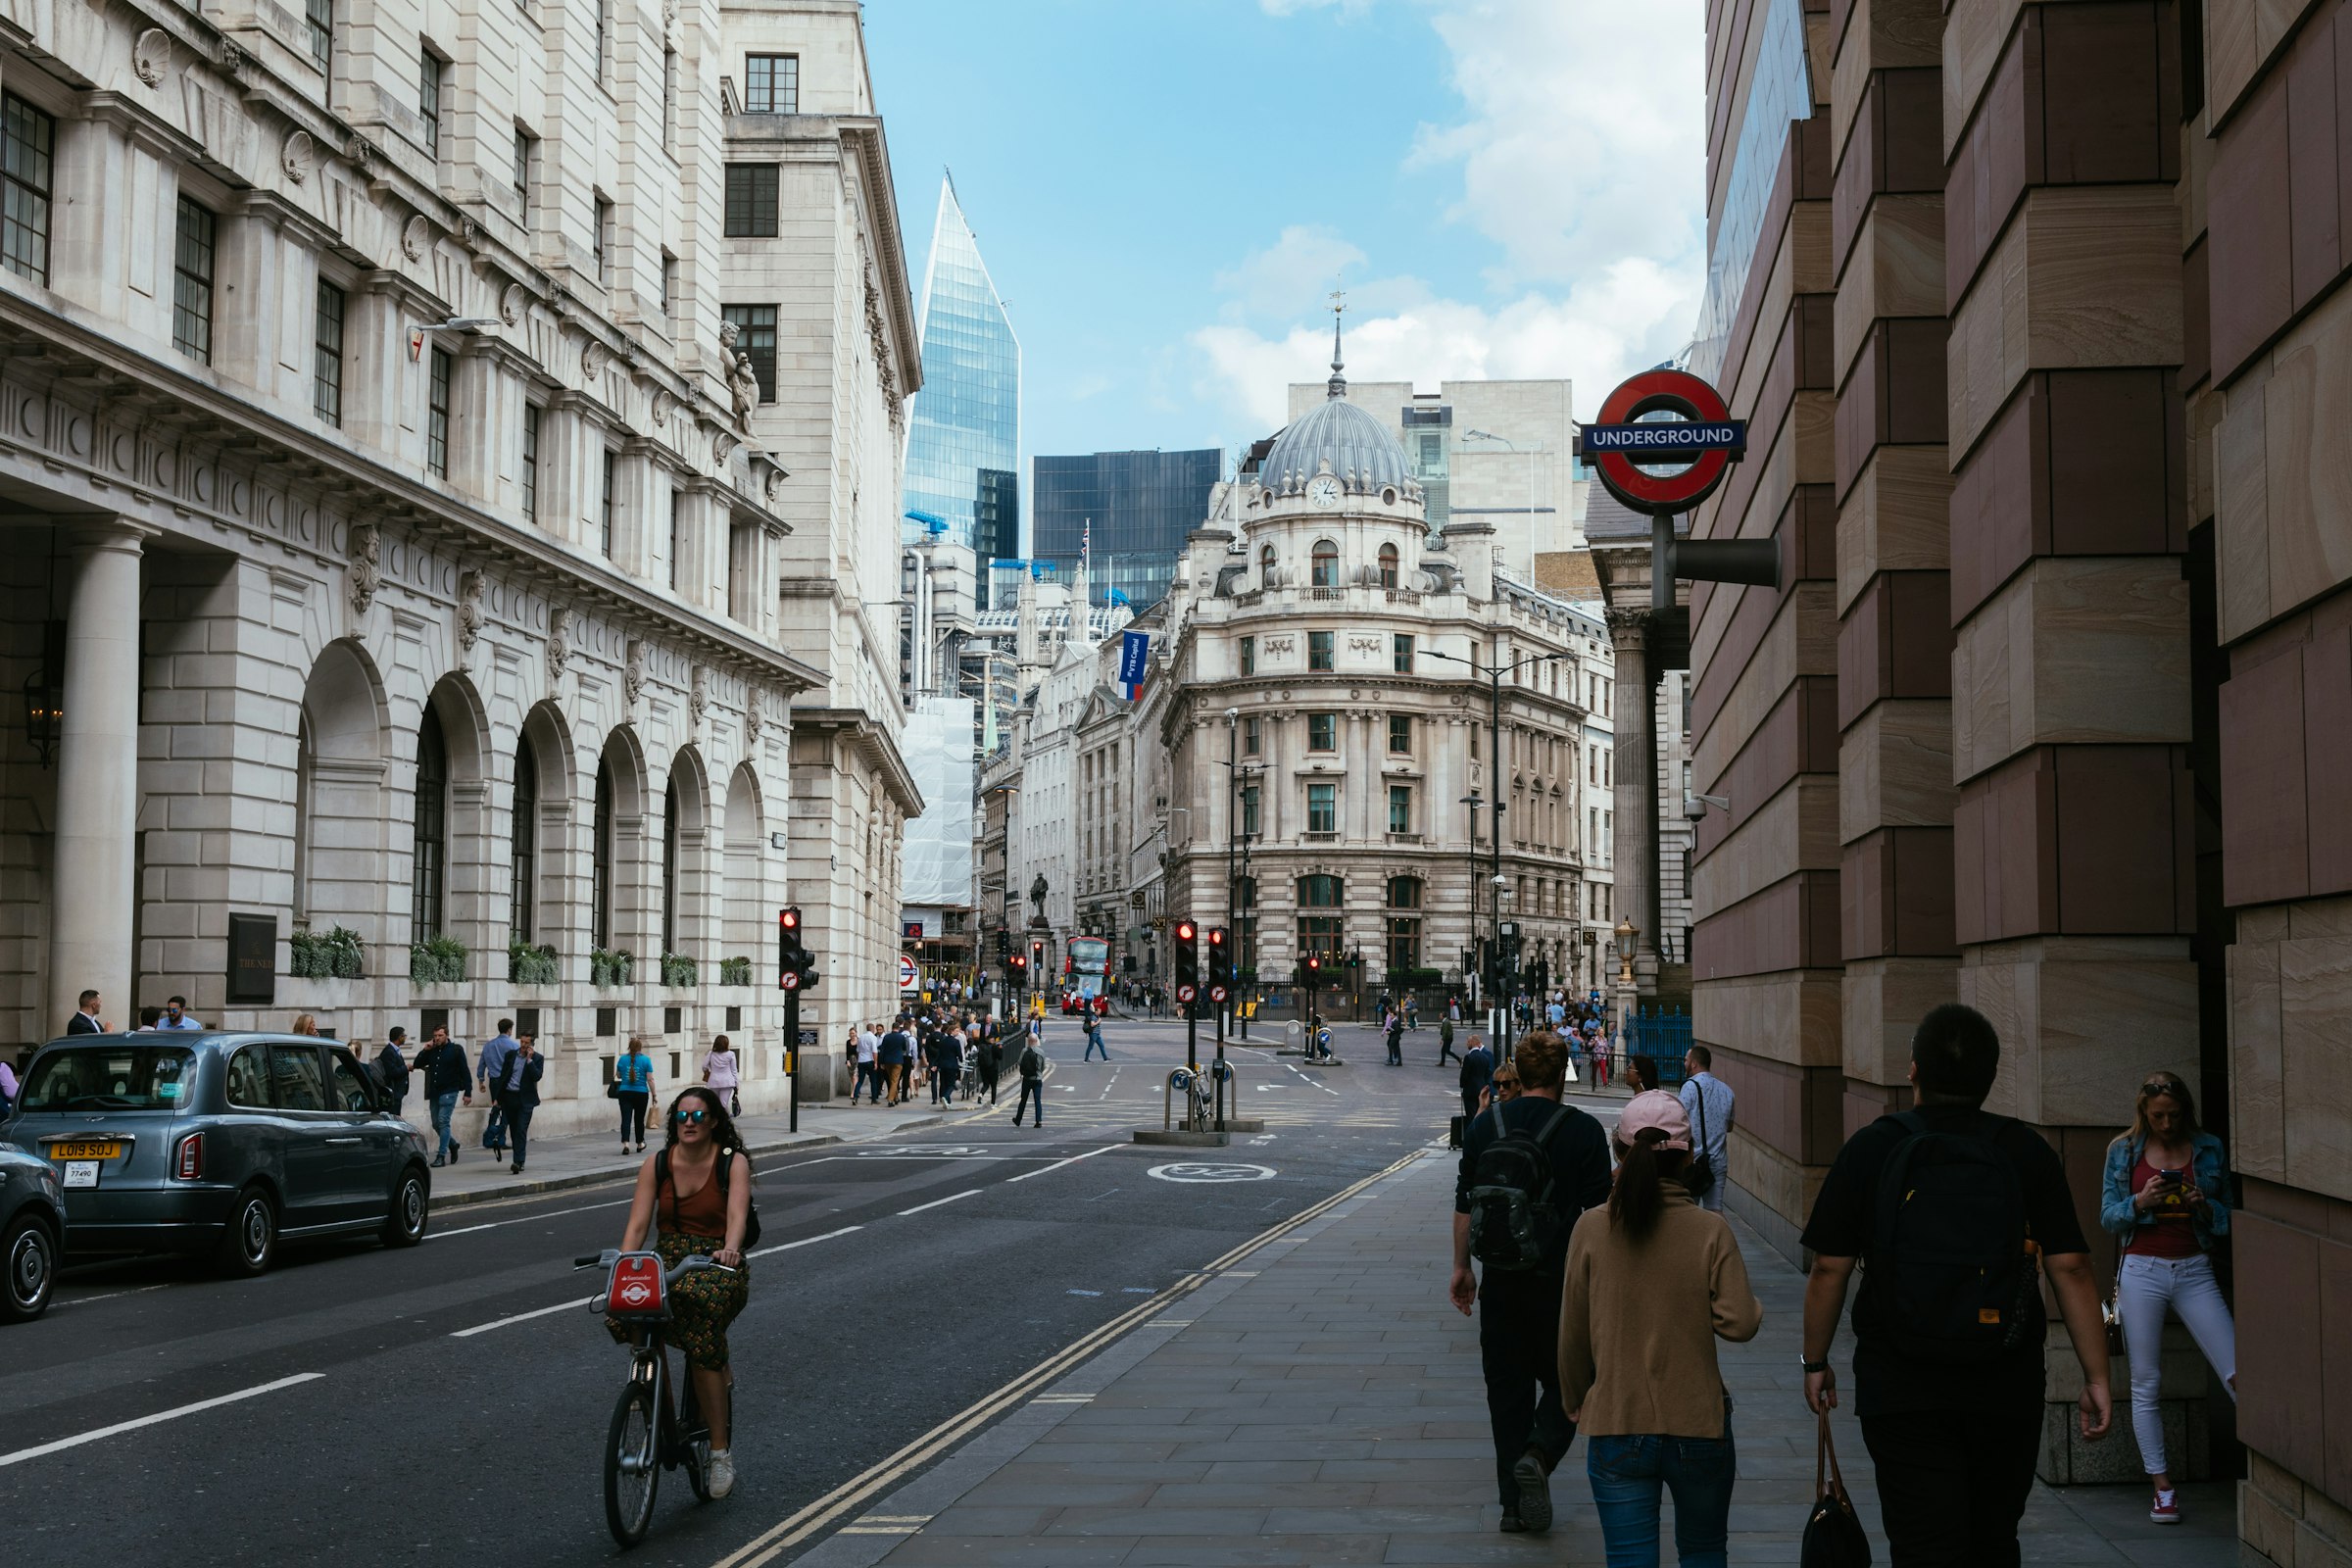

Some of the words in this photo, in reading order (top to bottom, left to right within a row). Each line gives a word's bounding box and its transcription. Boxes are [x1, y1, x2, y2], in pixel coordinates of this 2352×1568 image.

[1592, 428, 1734, 446] UNDERGROUND
[1130, 638, 1140, 659] Capital
[1127, 660, 1137, 678] #VTB
[1584, 932, 1594, 942] 82
[239, 957, 255, 968] THE
[257, 958, 273, 969] NED
[59, 1145, 86, 1156] LO19
[89, 1144, 114, 1155] SOJ
